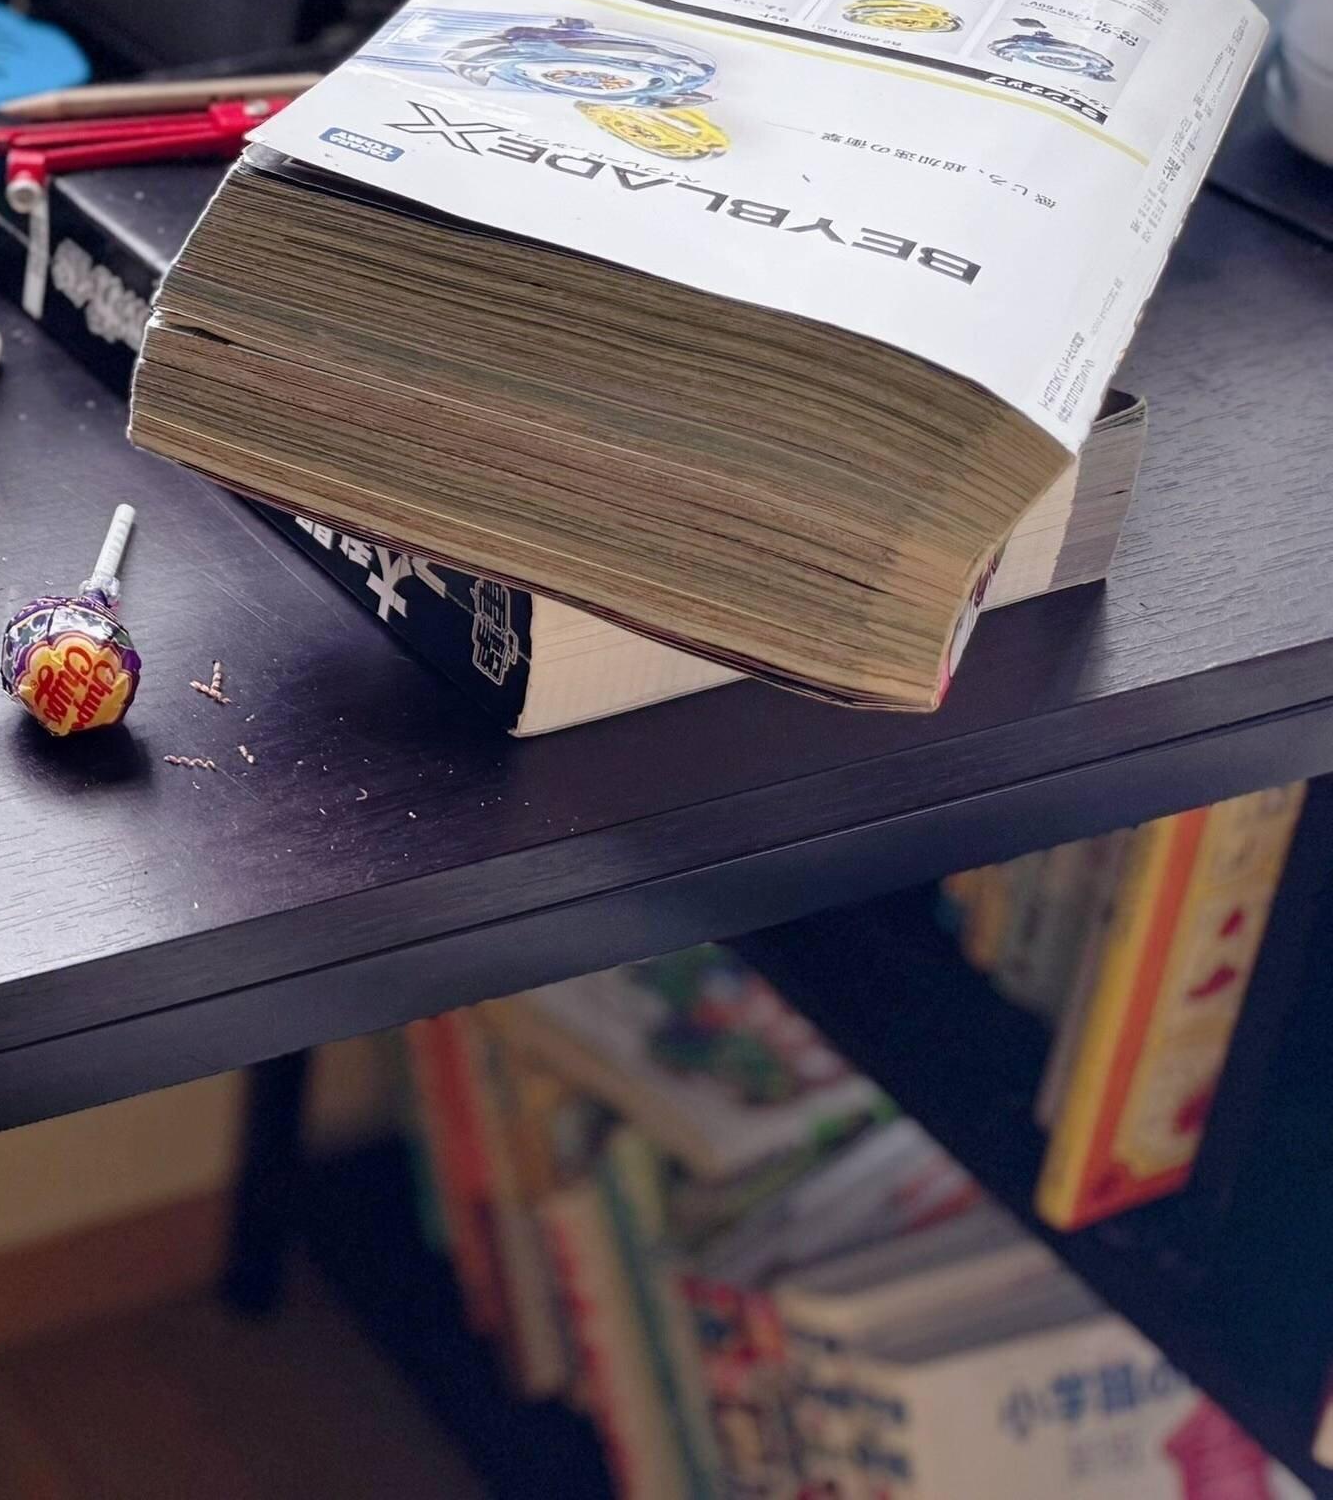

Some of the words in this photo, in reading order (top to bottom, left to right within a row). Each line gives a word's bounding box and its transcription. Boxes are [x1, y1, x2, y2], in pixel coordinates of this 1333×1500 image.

[985, 74, 1099, 119] ラインナップ
